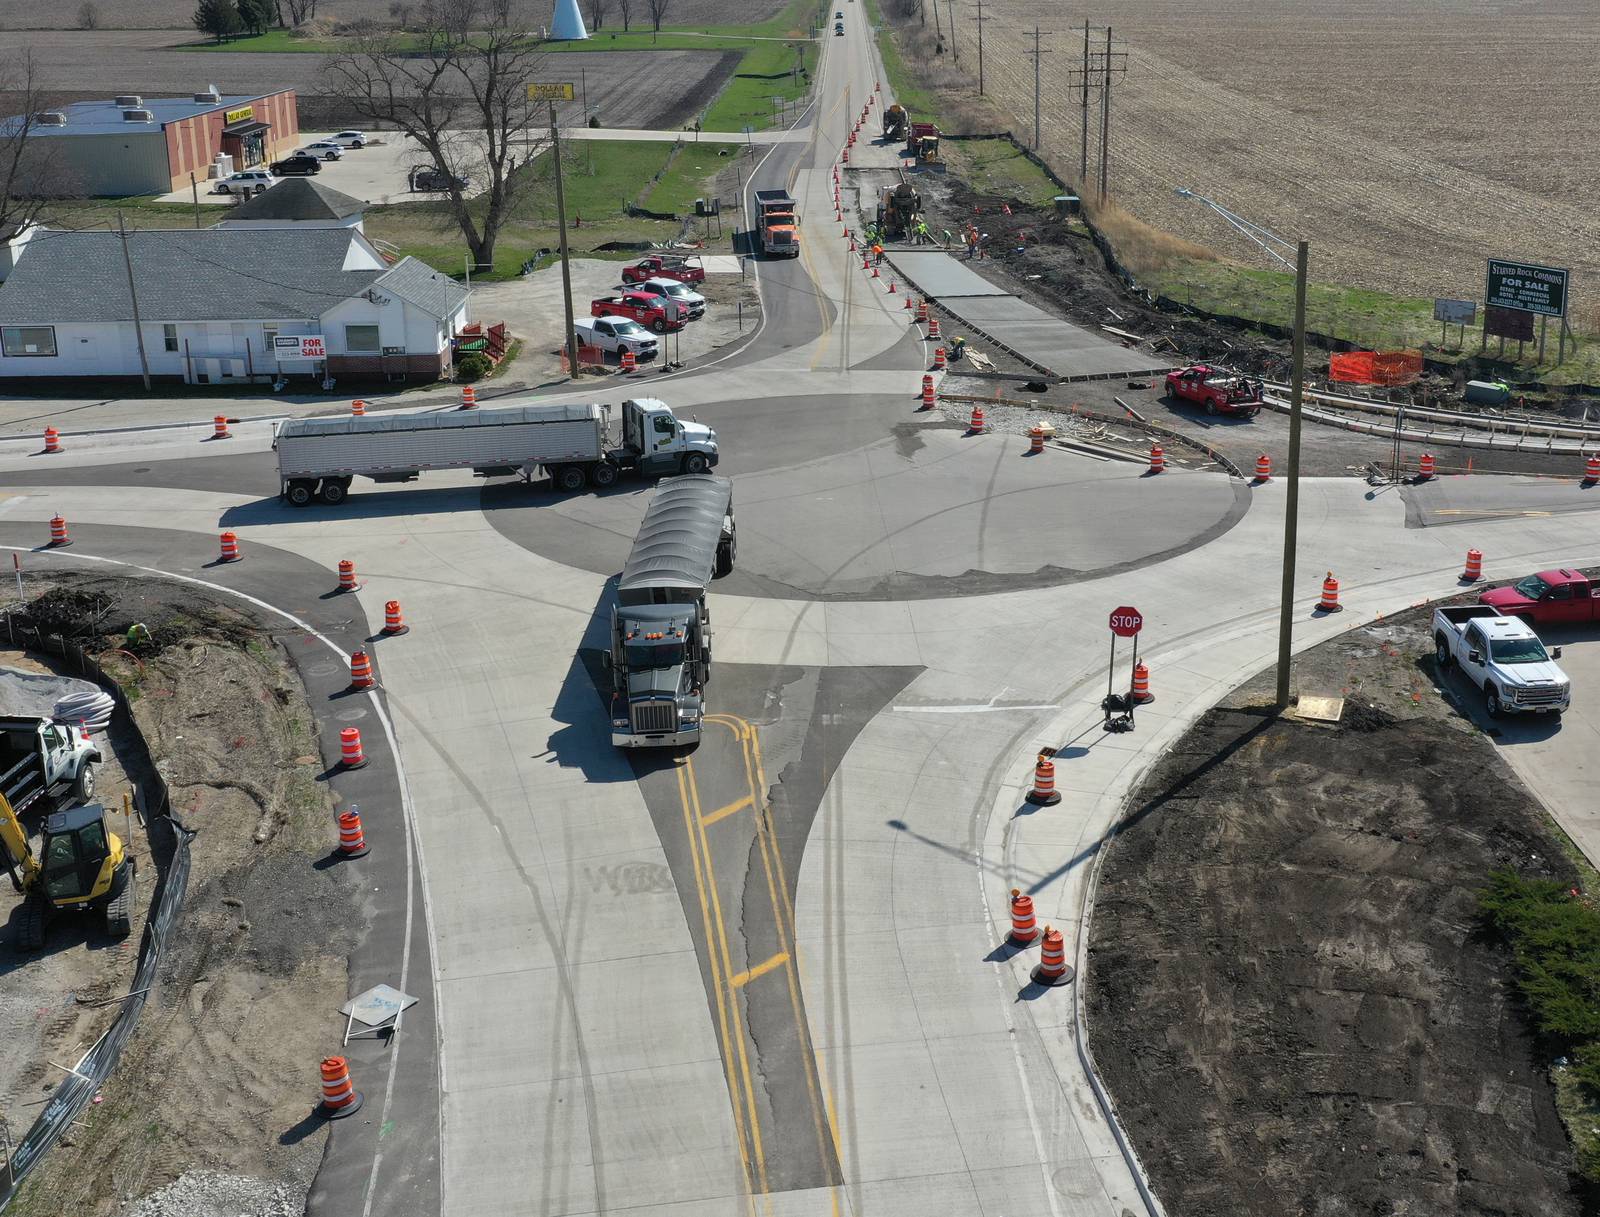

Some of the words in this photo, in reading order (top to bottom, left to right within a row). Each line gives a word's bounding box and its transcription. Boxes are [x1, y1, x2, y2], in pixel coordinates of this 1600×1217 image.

[1492, 264, 1516, 276] STARVED
[1517, 268, 1533, 277] ROCK
[1533, 270, 1563, 285] COMMONS
[1502, 277, 1522, 288] FOR
[1525, 281, 1550, 292] SALE
[1520, 290, 1550, 299] COMMERCIAL
[1532, 297, 1550, 305] FAMILY
[302, 339, 321, 347] FOR
[302, 348, 325, 357] SALE
[1111, 615, 1141, 628] STOP
